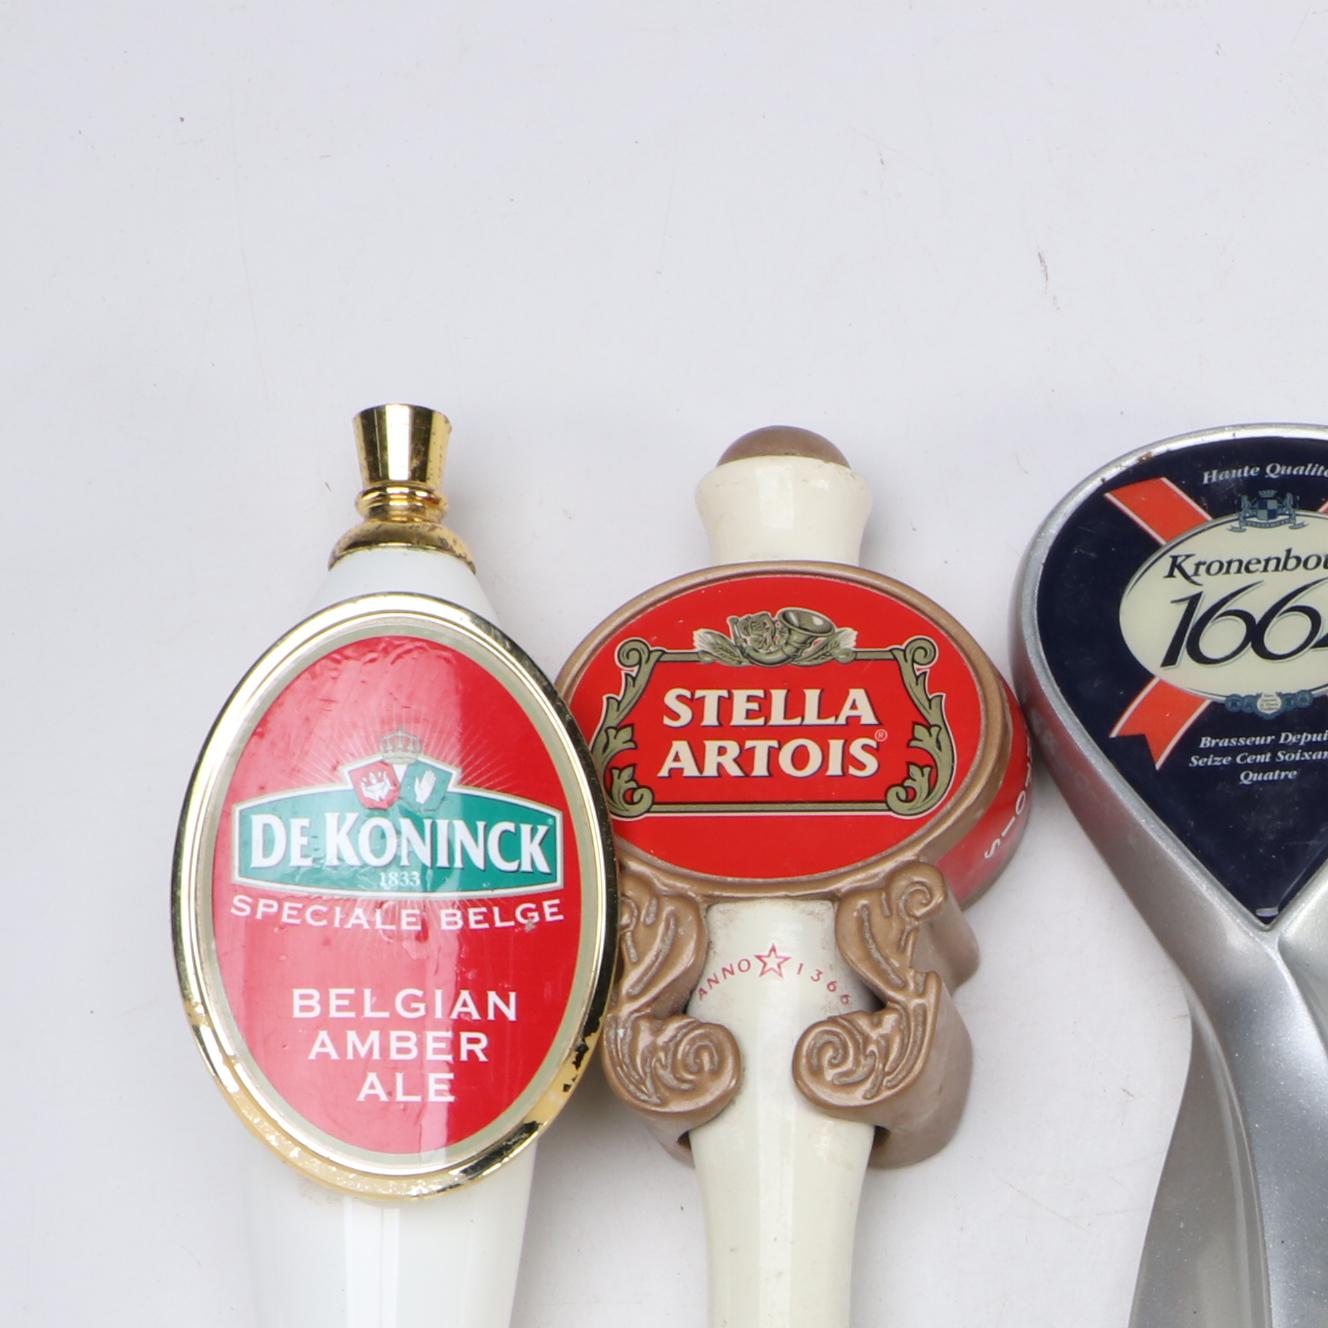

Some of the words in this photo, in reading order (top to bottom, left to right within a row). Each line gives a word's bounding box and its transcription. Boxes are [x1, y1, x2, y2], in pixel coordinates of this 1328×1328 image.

[1202, 465, 1261, 485] Haute
[662, 688, 878, 728] STELLA
[1200, 733, 1275, 749] Brasseur
[1189, 753, 1232, 767] Seize
[1236, 752, 1271, 766] Cent
[1240, 769, 1298, 784] Quatre
[250, 813, 316, 868] DE
[324, 811, 553, 874] KONINCK
[380, 871, 420, 887] 1833
[230, 895, 421, 932] SPECIALE
[440, 900, 565, 932] BELGE
[698, 957, 751, 1000] ANNO
[797, 962, 850, 1005] 1366
[292, 988, 518, 1021] BELGIAN
[308, 1030, 489, 1063] AMBER
[356, 1072, 455, 1103] ALE
